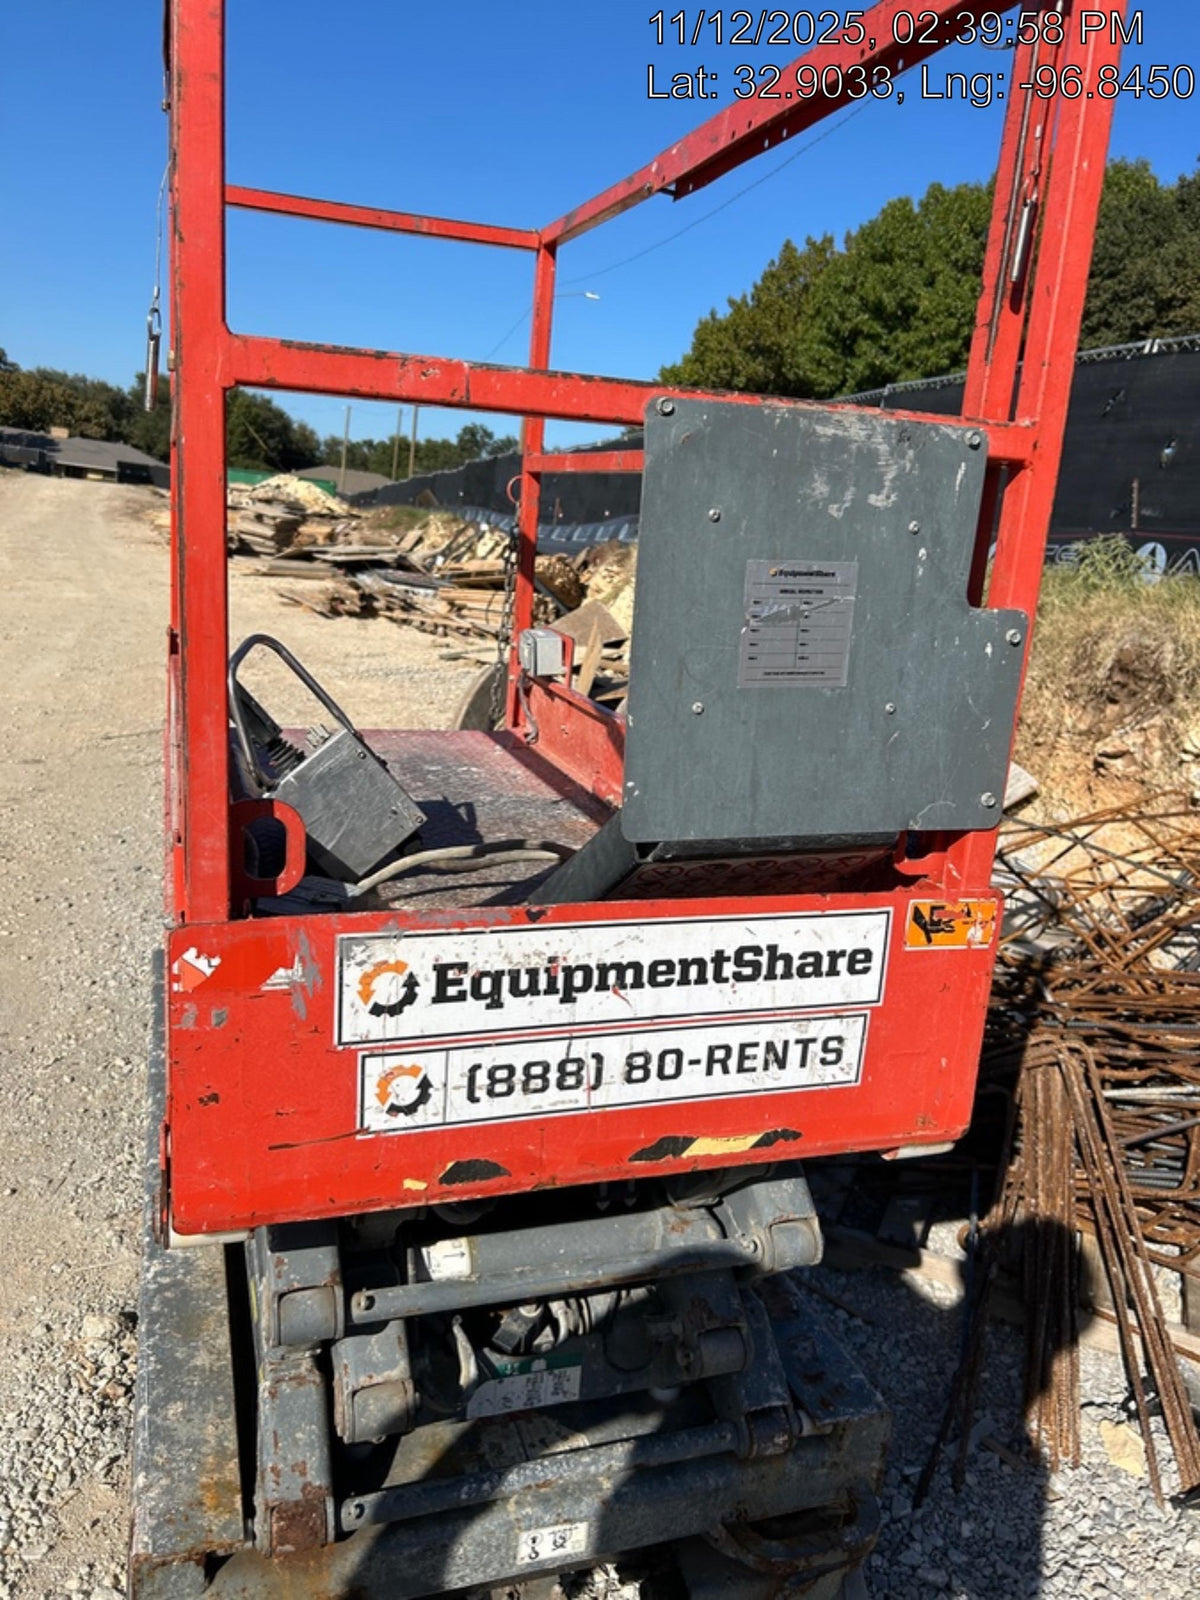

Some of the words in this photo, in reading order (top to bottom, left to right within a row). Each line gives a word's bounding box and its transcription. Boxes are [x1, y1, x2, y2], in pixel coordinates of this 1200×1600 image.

[431, 945, 873, 1010] EquipmentShare
[466, 1052, 604, 1103] (888)
[624, 1035, 844, 1085] 80-RENTS
